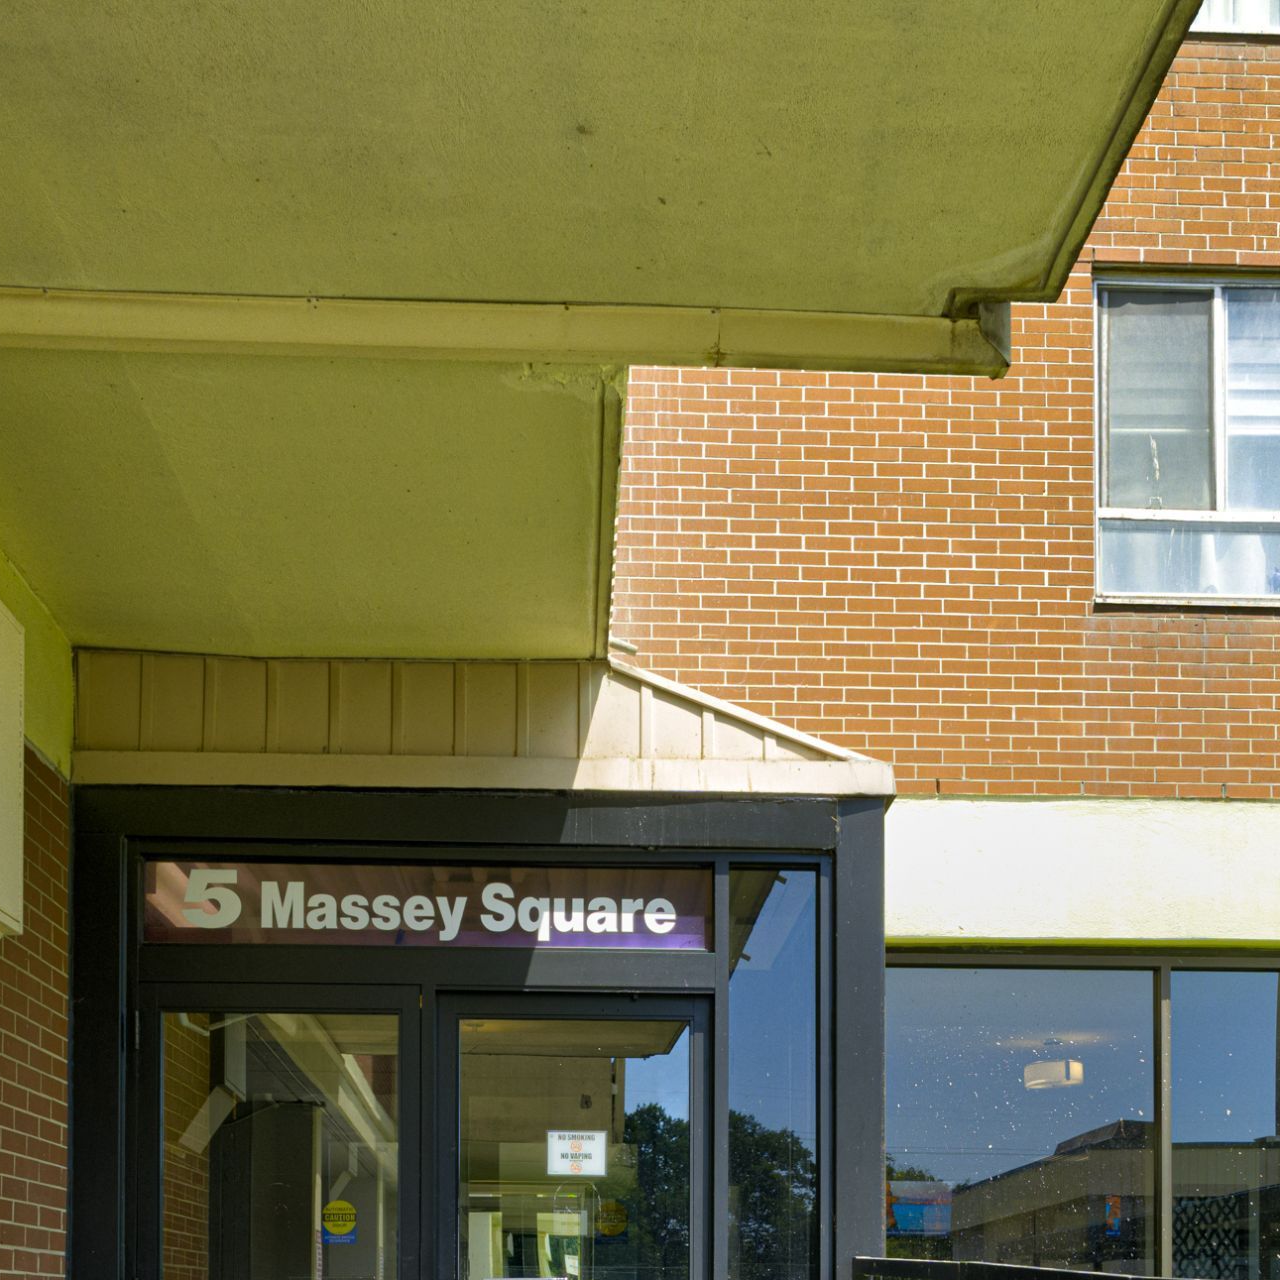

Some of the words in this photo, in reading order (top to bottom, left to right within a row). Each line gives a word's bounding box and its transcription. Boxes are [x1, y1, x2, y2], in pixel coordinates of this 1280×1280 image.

[181, 868, 242, 929] 5
[260, 880, 468, 942] Massey
[480, 881, 677, 942] Square
[560, 1152, 569, 1160] NO
[570, 1152, 593, 1160] VAPING
